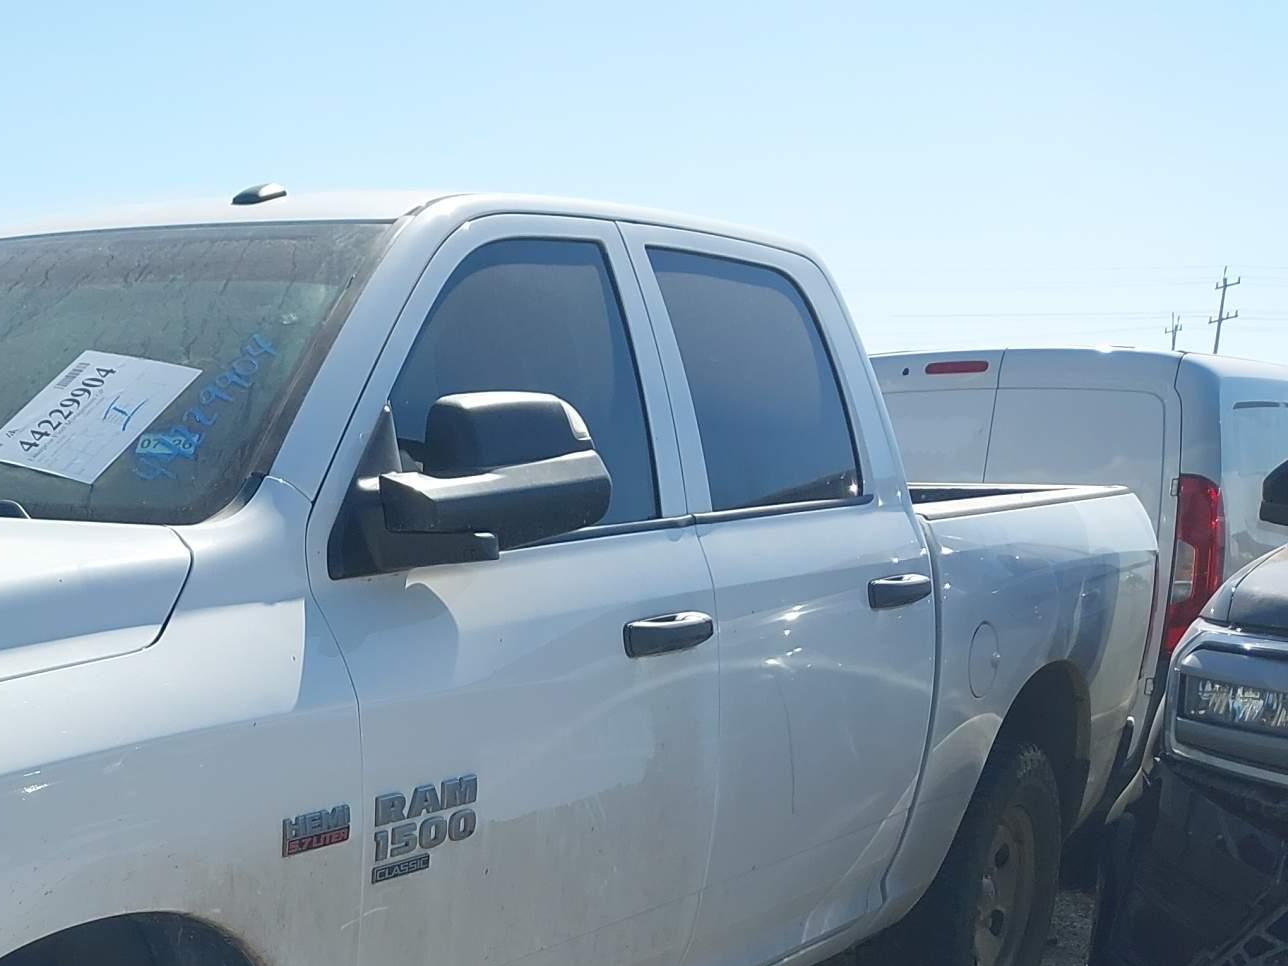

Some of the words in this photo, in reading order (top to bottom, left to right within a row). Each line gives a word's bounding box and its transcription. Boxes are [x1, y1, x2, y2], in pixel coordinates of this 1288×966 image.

[19, 367, 117, 453] 44229904
[282, 804, 351, 840] HEMI
[375, 774, 478, 827] RAM
[312, 830, 348, 848] LITER
[374, 808, 476, 861] 1500
[376, 857, 428, 881] CLASSIC
